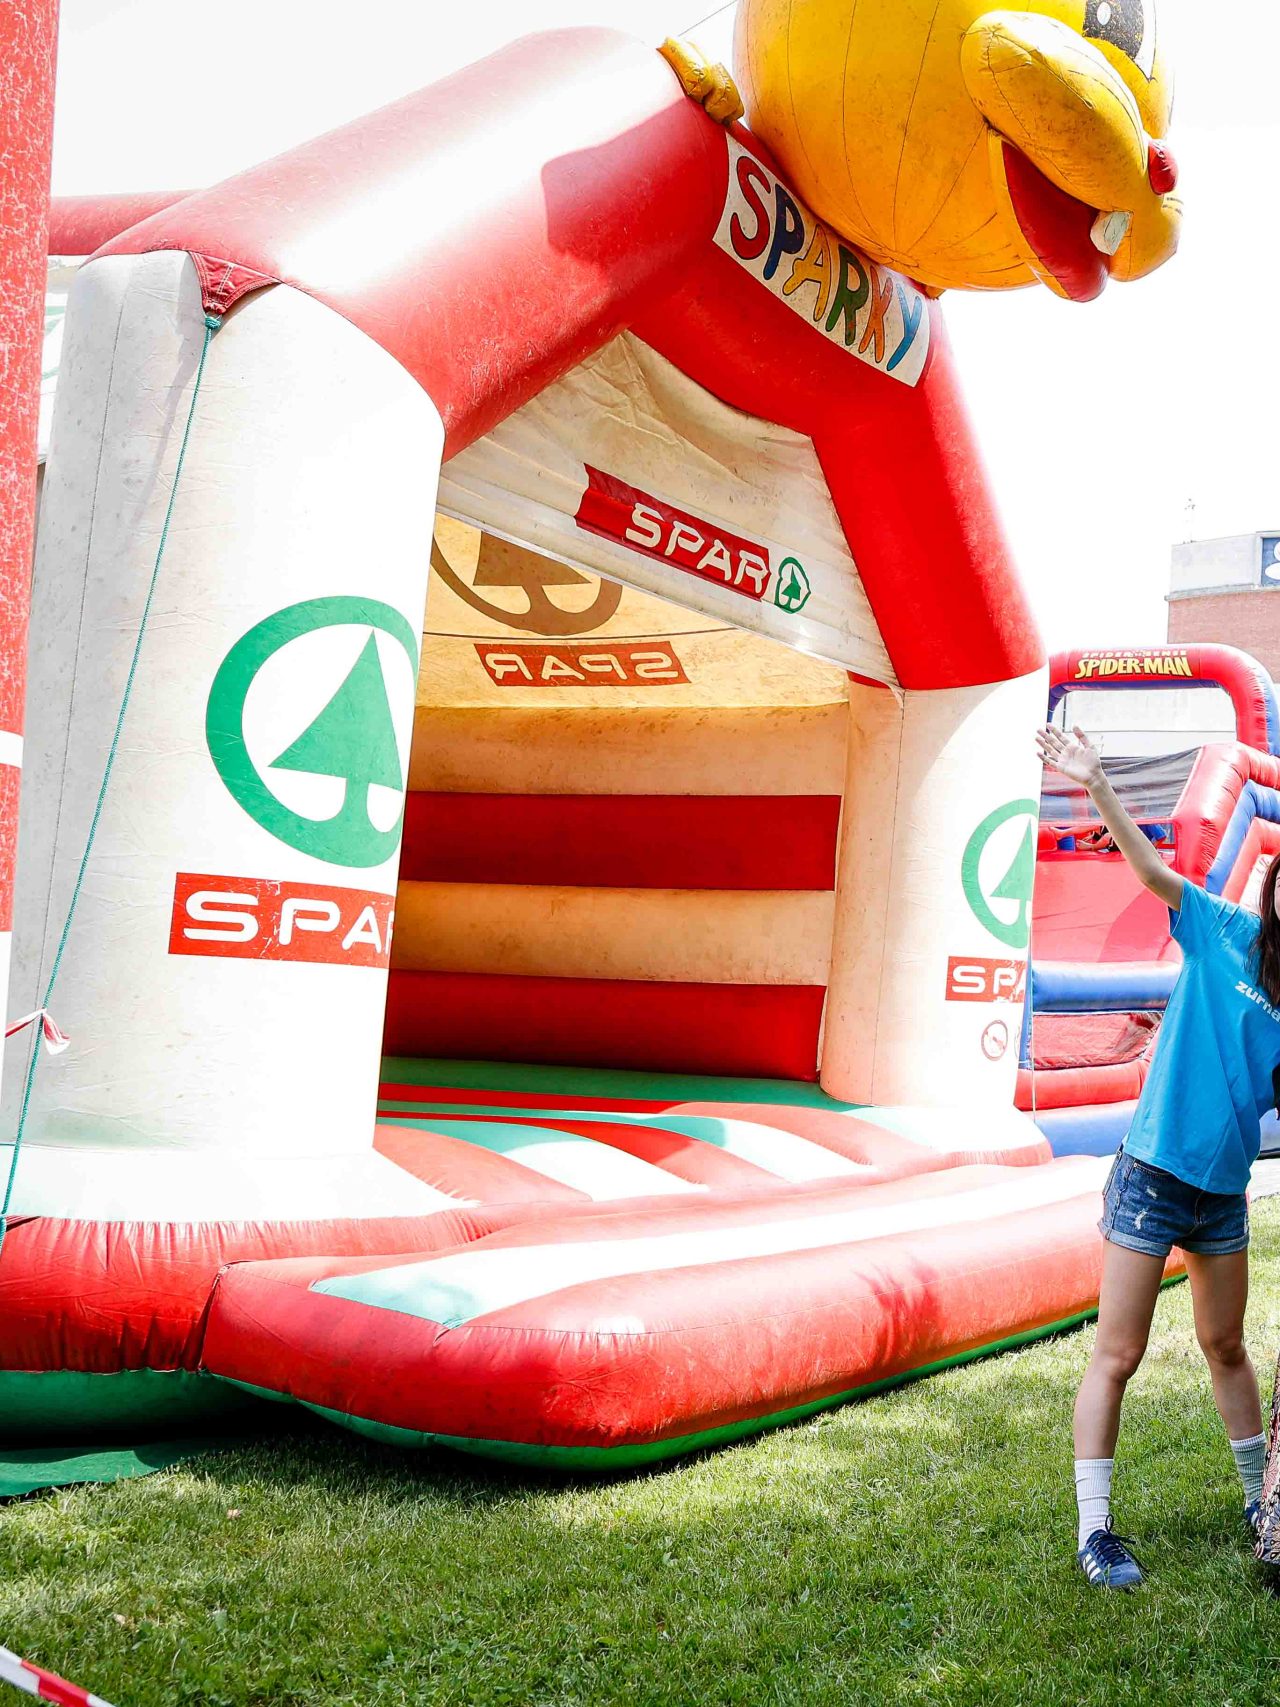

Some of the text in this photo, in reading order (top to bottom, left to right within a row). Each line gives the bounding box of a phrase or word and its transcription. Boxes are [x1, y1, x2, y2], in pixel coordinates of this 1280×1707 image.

[730, 155, 923, 372] SPARKY
[625, 502, 772, 594] SPAR
[1074, 657, 1193, 679] SPIDER-MAN
